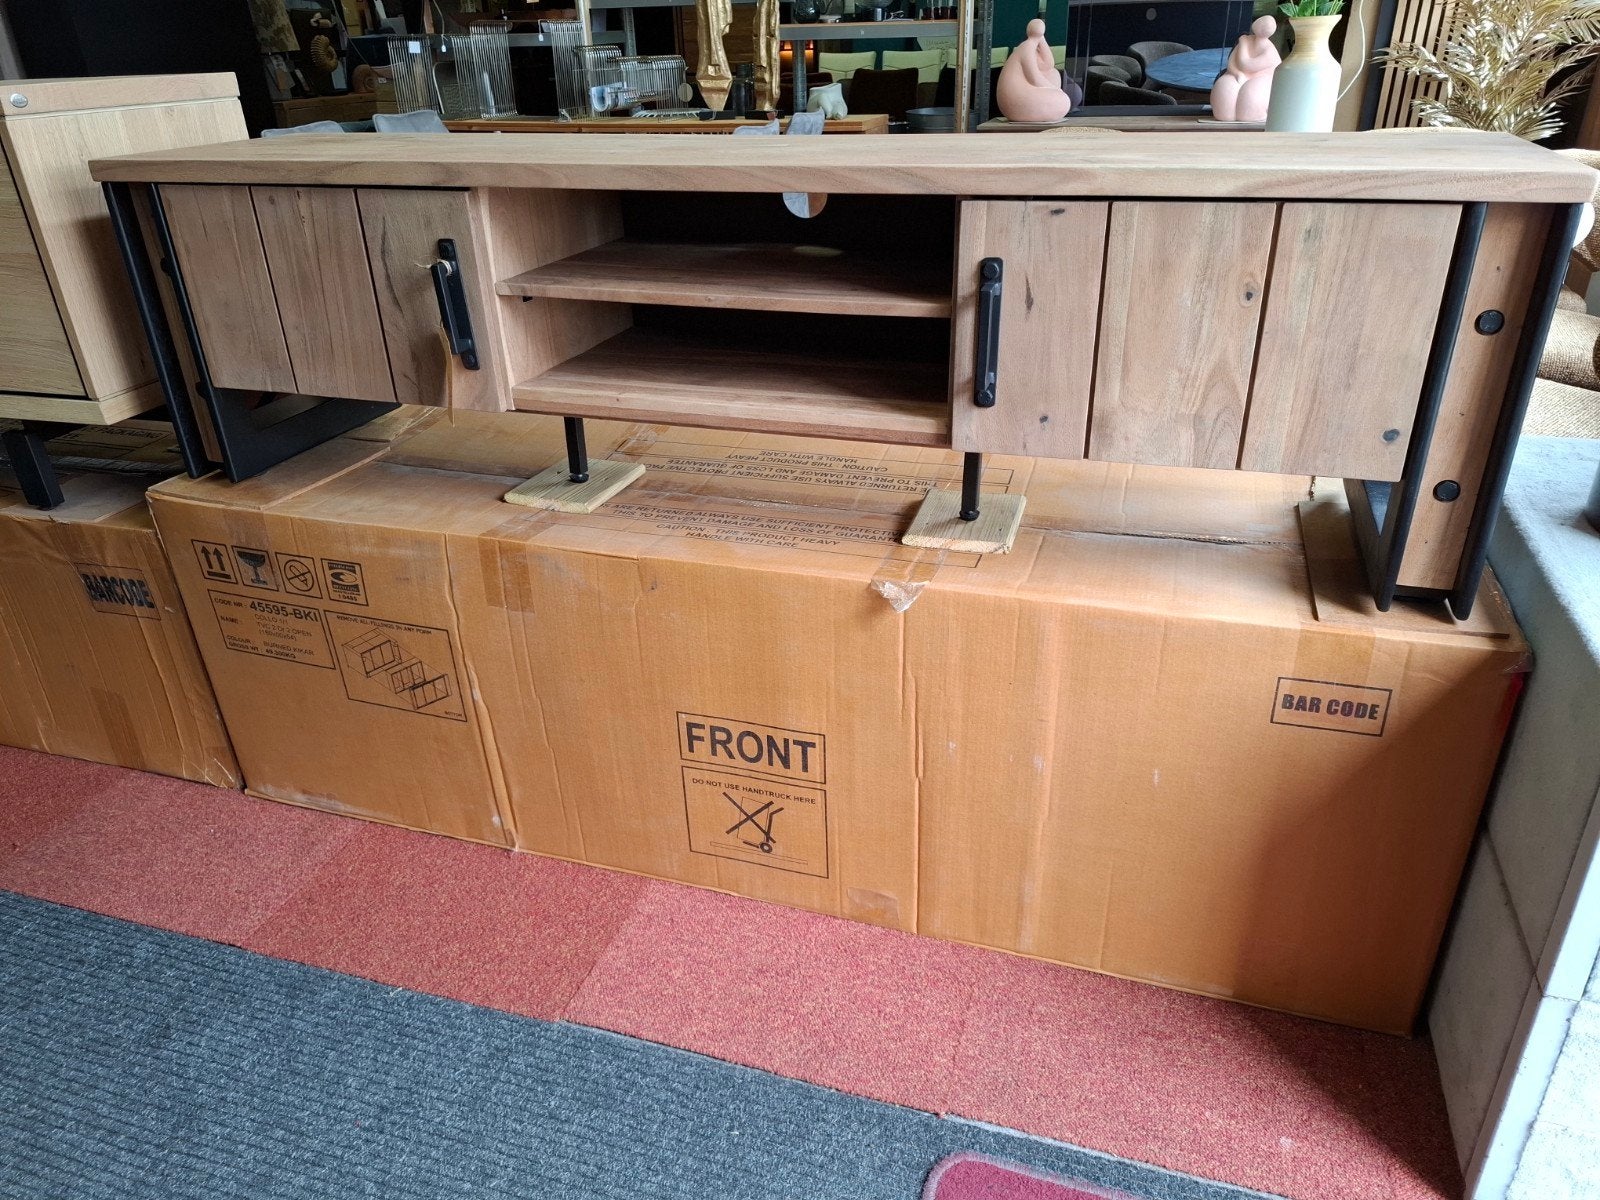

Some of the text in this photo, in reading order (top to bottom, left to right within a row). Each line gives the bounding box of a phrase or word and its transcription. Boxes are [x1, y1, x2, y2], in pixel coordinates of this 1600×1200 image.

[725, 454, 759, 462] HEAVY
[759, 457, 809, 466] PRODUCT
[787, 453, 814, 461] WITH
[820, 456, 858, 464] HANDLE
[667, 459, 728, 468] GUARANTEE
[841, 464, 888, 473] CAUTION
[667, 465, 726, 475] PROTECTIVE
[729, 469, 790, 480] SUFFICIENT
[800, 471, 844, 480] DAMAGE
[848, 474, 895, 484] PREVENT
[814, 477, 857, 487] ALWAYS
[859, 482, 917, 492] RETURNED
[914, 480, 938, 488] THIS
[636, 506, 694, 516] RETURNED
[696, 511, 739, 520] ALWAYS
[767, 518, 831, 530] SUFFICIENT
[655, 514, 703, 523] PREVENT
[706, 519, 753, 528] DAMAGE
[783, 526, 813, 534] LOSS
[655, 523, 706, 532] CAUTION
[742, 531, 799, 542] PRODUCT
[800, 537, 840, 546] HEAVY
[685, 532, 799, 548] HANDLE WITH CARE
[214, 597, 232, 607] CODE
[249, 601, 319, 622] 45595-BKI
[336, 615, 360, 624] REMOVE
[1281, 693, 1380, 720] BAR CODE
[685, 721, 817, 773] FRONT
[692, 777, 816, 805] DO NOT USE HANDTRUCK HERE
